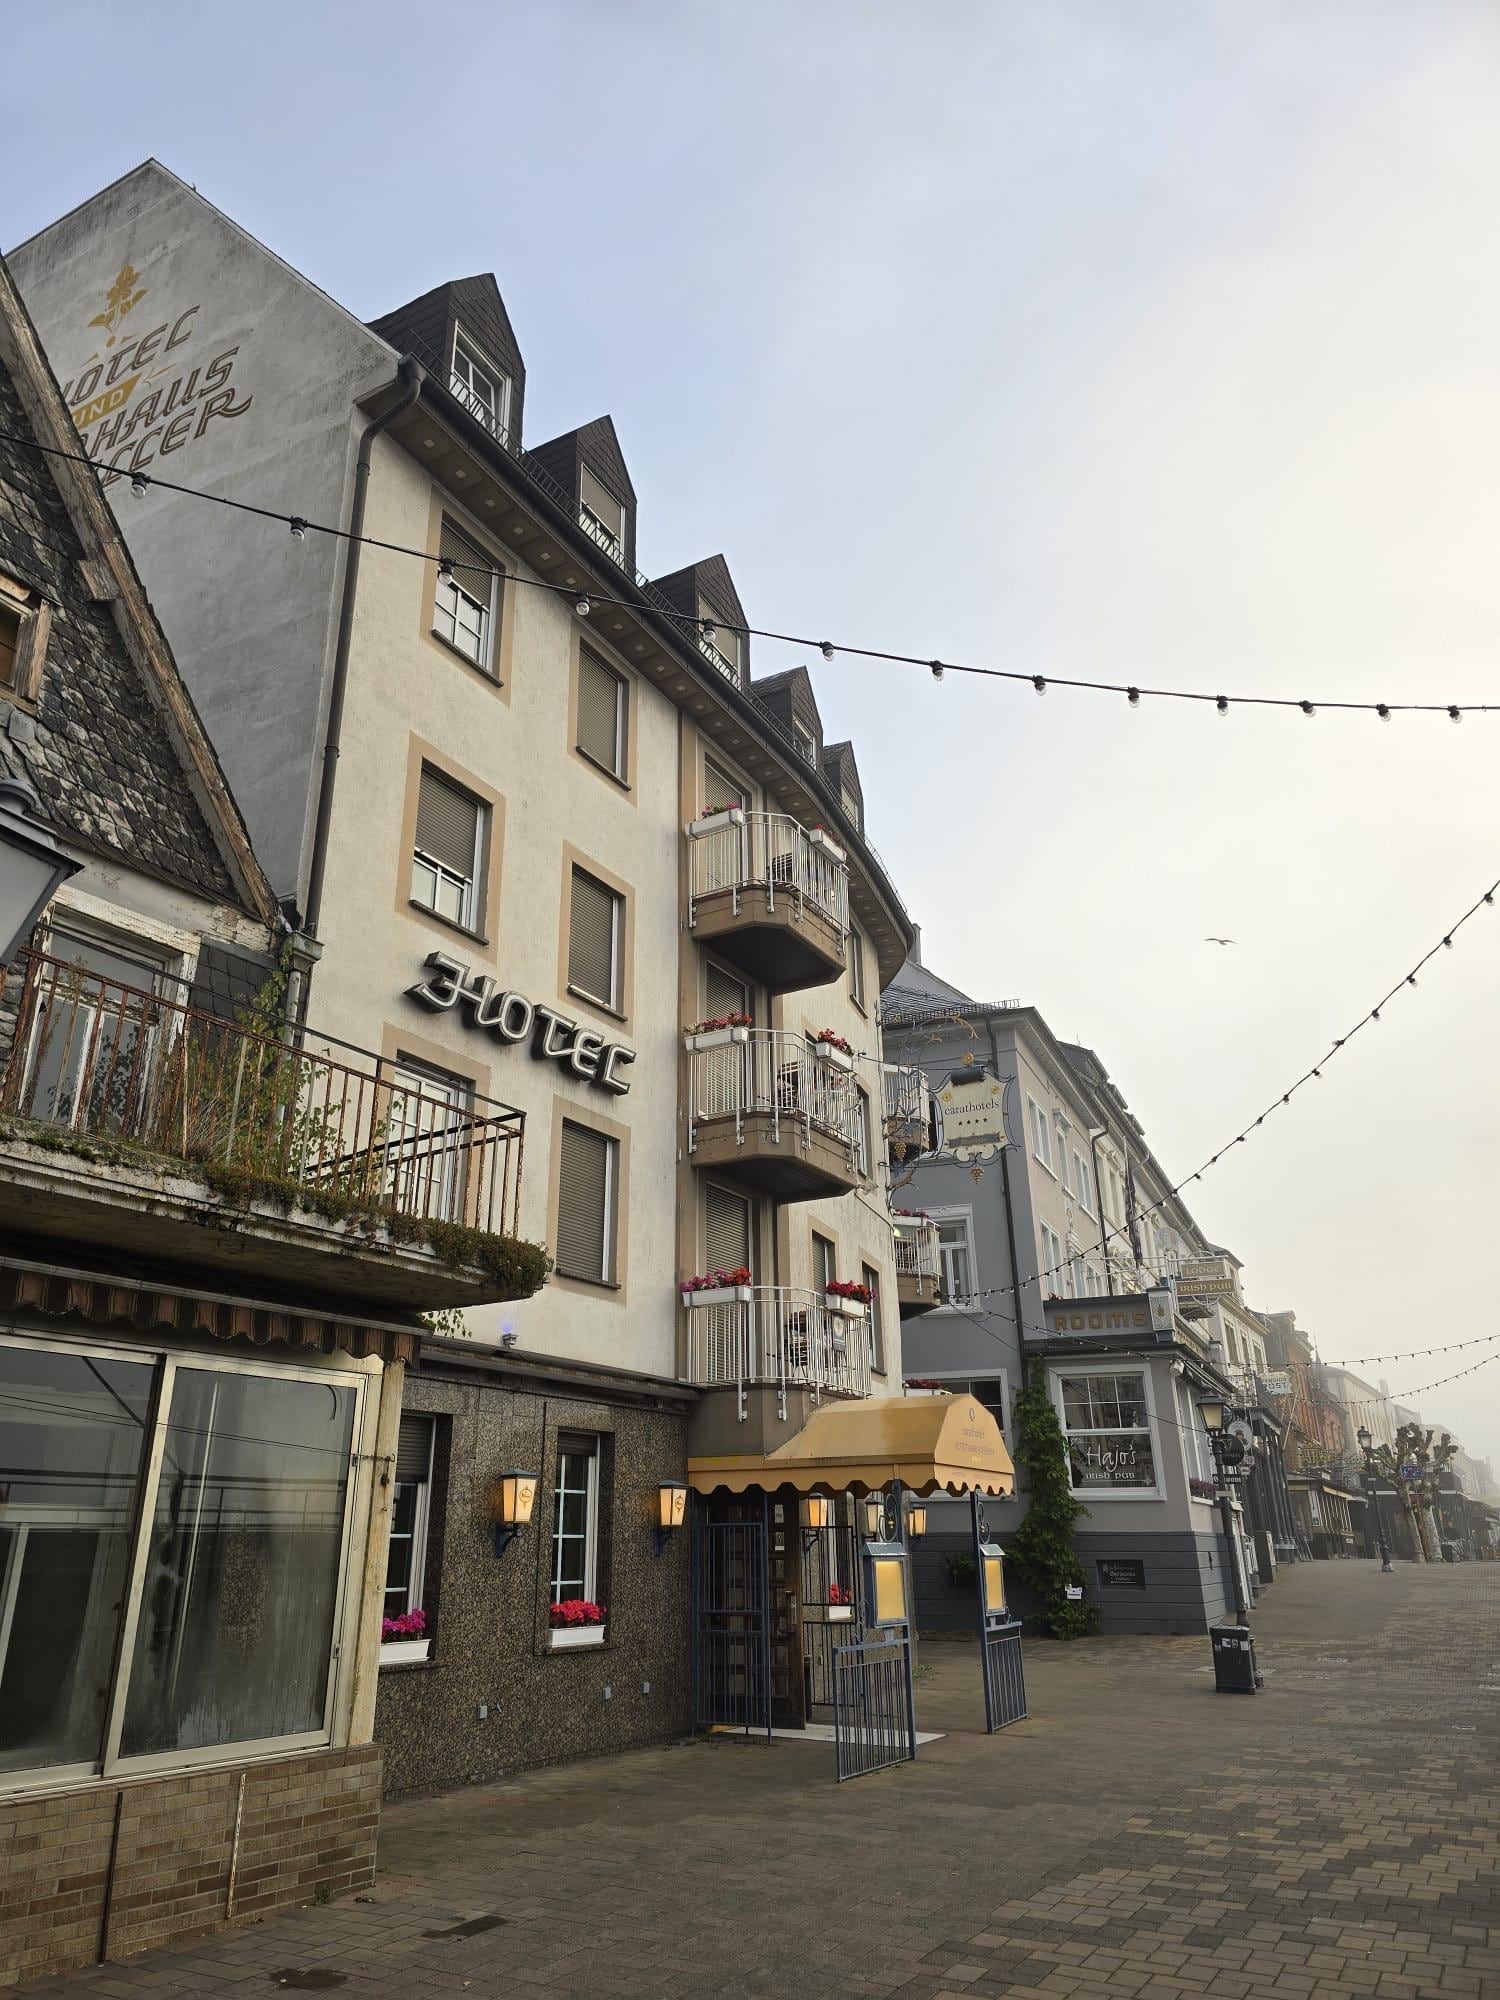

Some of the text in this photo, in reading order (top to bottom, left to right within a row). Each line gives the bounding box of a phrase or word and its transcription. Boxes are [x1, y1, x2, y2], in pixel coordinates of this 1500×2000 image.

[403, 951, 637, 1097] HOTEL
[944, 1098, 1000, 1116] carathotels
[1055, 1311, 1146, 1331] ROOMS
[1086, 1443, 1137, 1473] Hajo's
